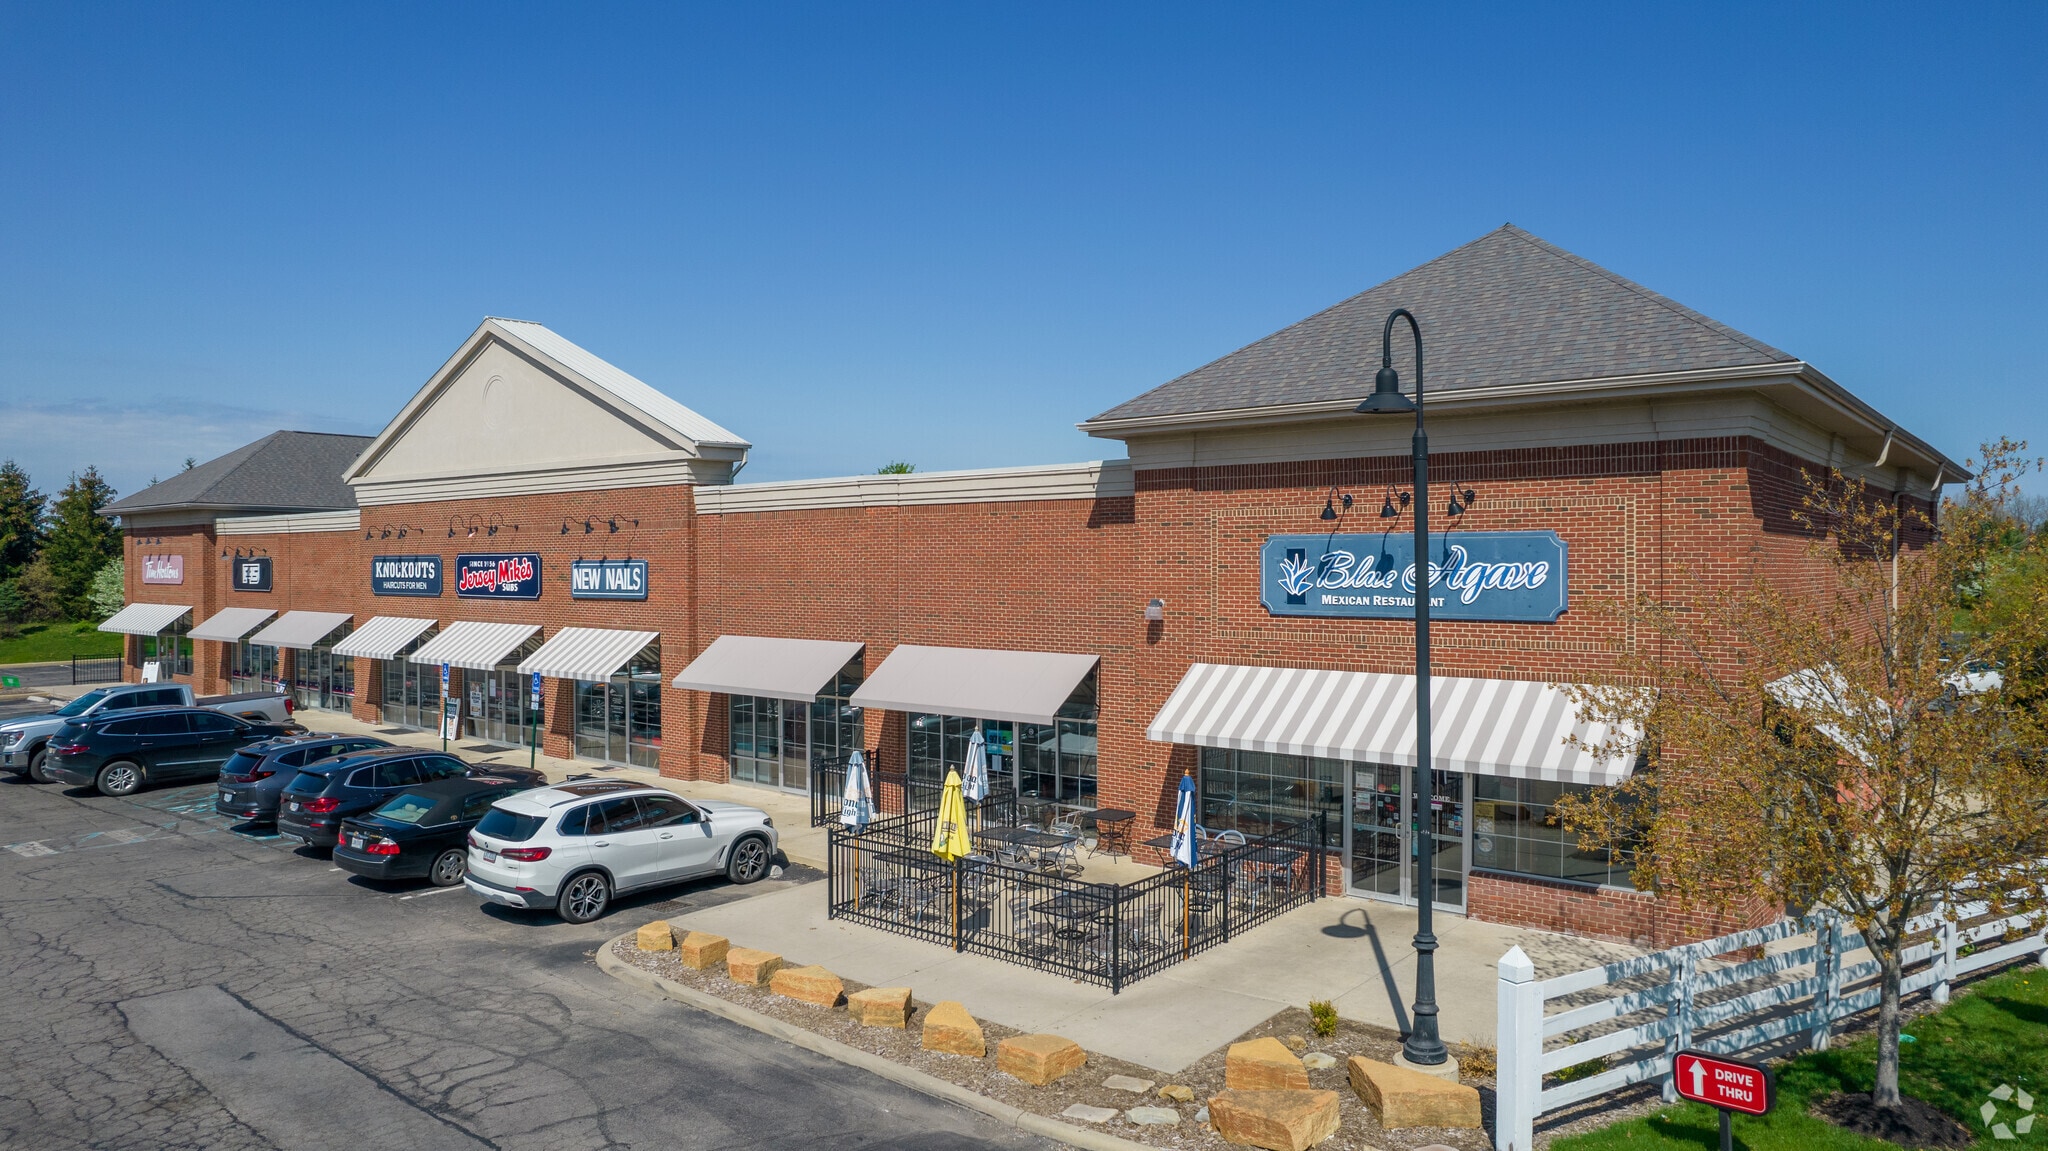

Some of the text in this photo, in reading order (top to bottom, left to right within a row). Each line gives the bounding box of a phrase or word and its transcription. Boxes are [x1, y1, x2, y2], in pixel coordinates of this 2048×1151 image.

[145, 560, 179, 579] Tim Hortons
[375, 561, 435, 579] KNOCKOUTS
[469, 560, 483, 568] SINCE
[459, 557, 533, 592] Jersey Mike's
[574, 567, 641, 591] NEW NAILS
[1317, 545, 1549, 605] Blue Agave
[383, 581, 406, 590] HAIRCUTS
[416, 582, 427, 590] MEN
[502, 583, 518, 592] SUBS
[1321, 594, 1445, 607] MEXICAN RESTAUNT
[1715, 1068, 1754, 1087] DRIVE
[1717, 1084, 1753, 1102] THRU
